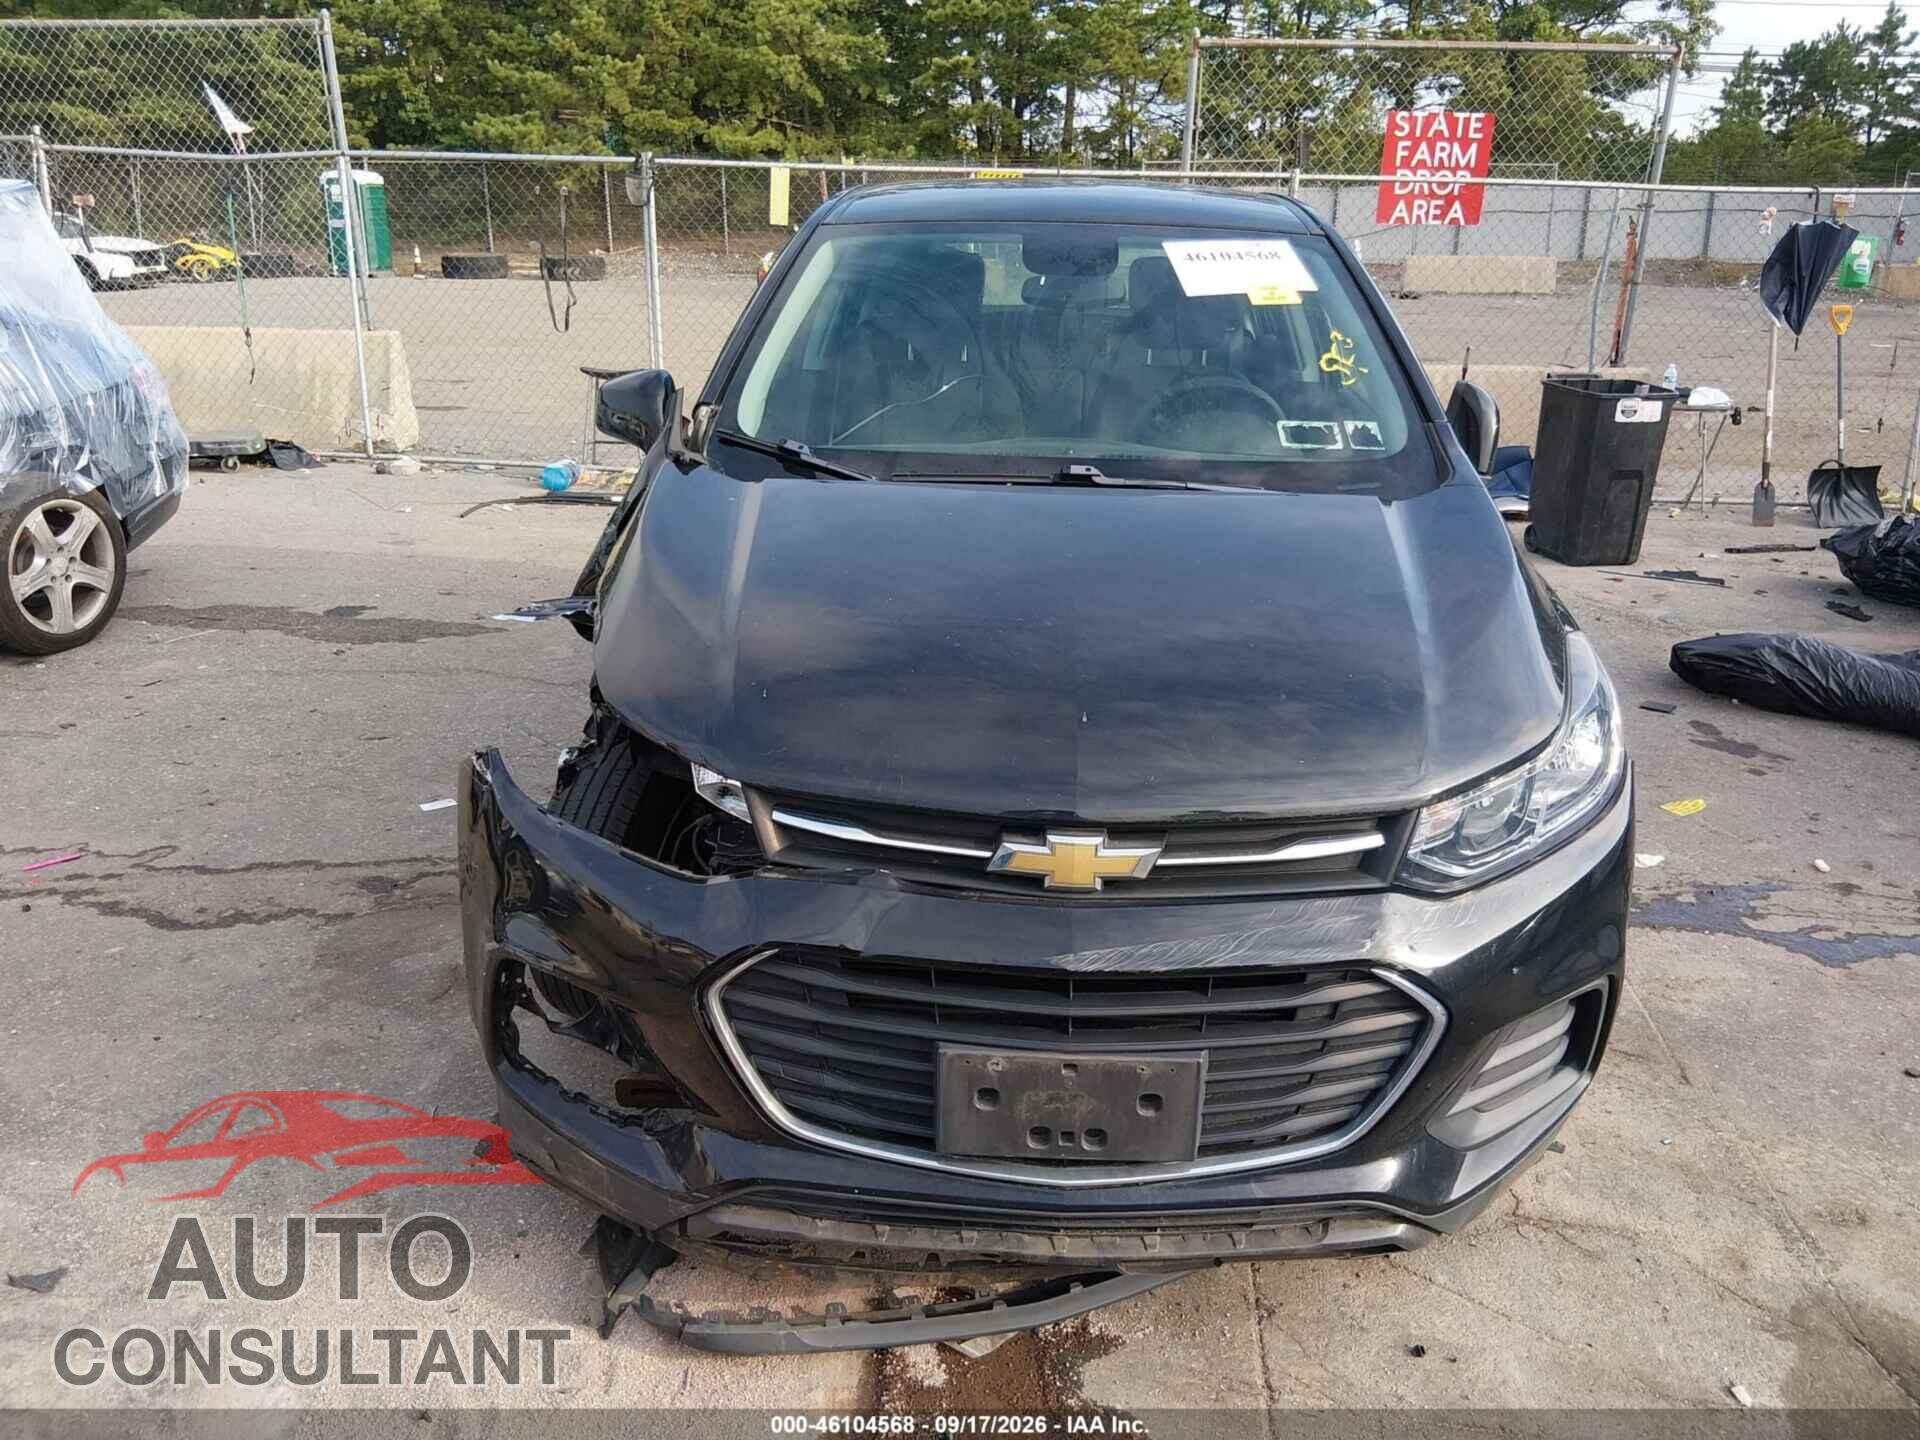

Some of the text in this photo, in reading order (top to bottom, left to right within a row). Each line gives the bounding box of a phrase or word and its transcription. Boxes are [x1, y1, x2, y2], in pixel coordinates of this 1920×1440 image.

[1393, 110, 1486, 139] STATE
[1395, 140, 1479, 168] FARM
[1393, 169, 1472, 196] DROP
[1388, 199, 1466, 225] AREA
